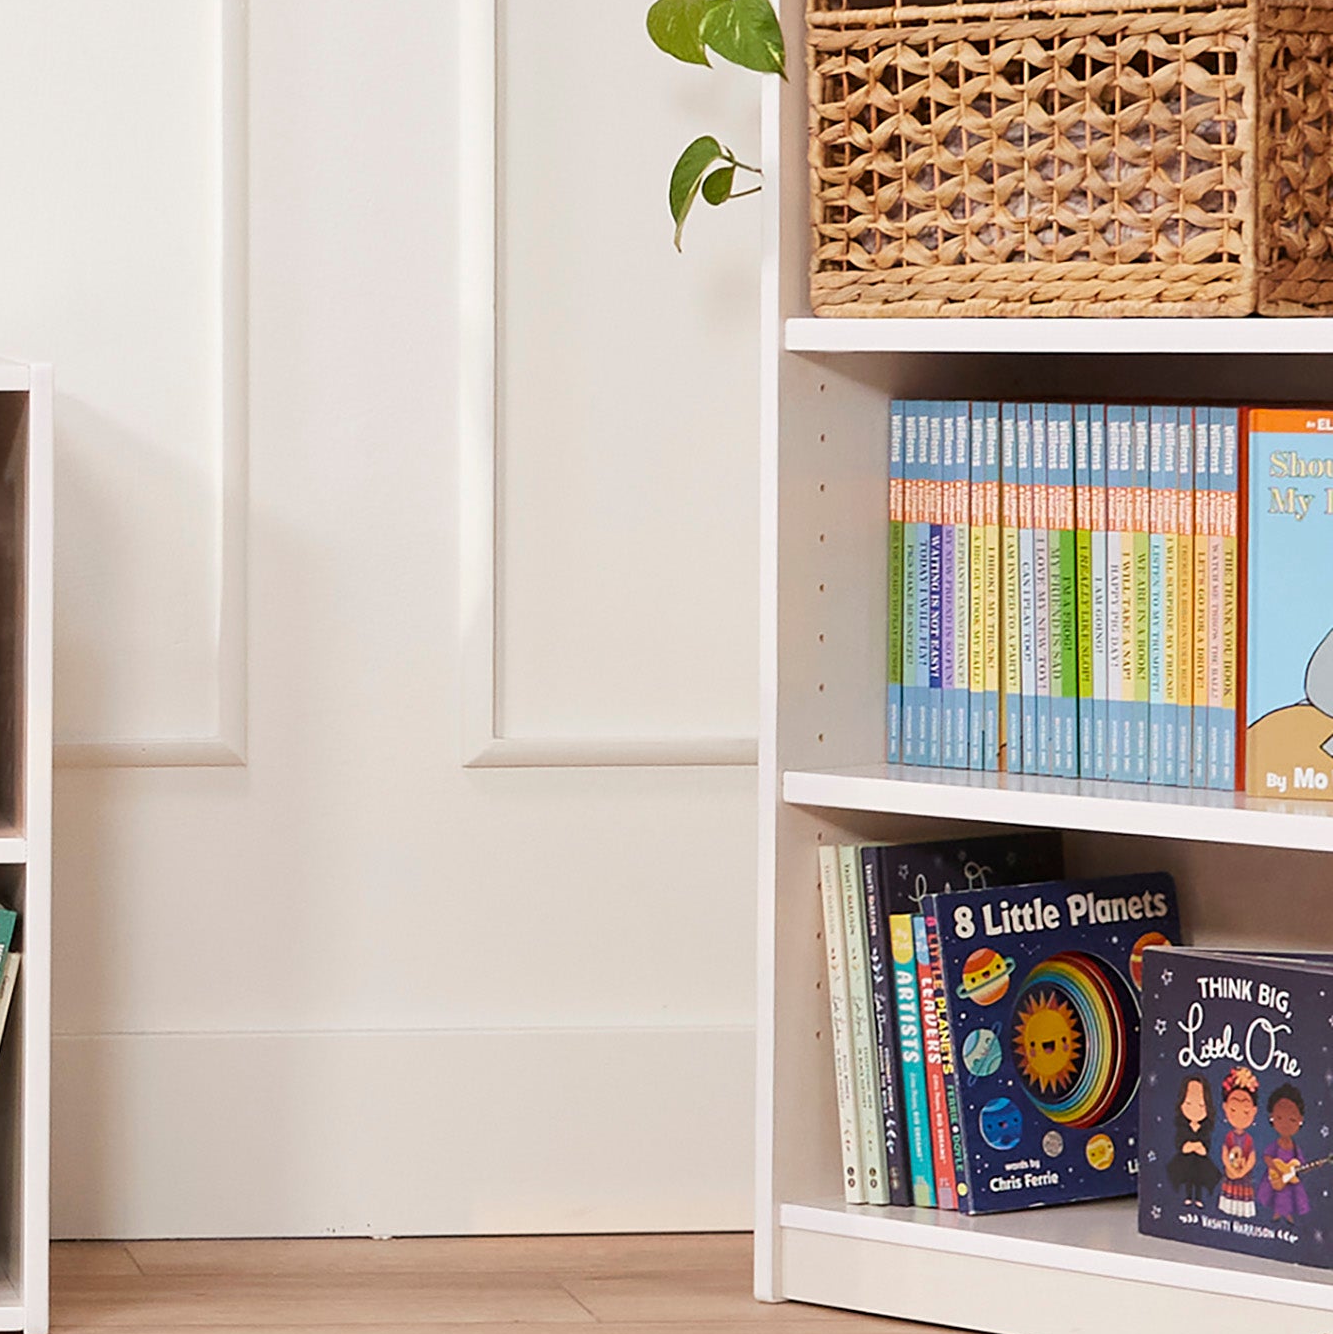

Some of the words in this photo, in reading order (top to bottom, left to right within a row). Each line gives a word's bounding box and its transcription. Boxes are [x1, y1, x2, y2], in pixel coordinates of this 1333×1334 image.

[891, 414, 902, 462] Willems
[956, 416, 967, 464] Willems
[1033, 420, 1043, 468] Willems
[1091, 421, 1103, 471] Willems
[1135, 421, 1147, 471] Willems
[1164, 423, 1176, 472] Willems
[1179, 424, 1190, 474] Willems
[1224, 425, 1235, 475] Willems
[1268, 487, 1315, 521] My
[919, 541, 927, 584] TODAY
[931, 535, 940, 592] WAITING
[1037, 548, 1045, 586] LOVE
[1050, 547, 1060, 567] MY
[1137, 553, 1145, 580] WE
[1224, 550, 1233, 577] THE
[987, 553, 995, 599] BROKE
[1095, 584, 1103, 605] AM
[1110, 564, 1118, 606] HAPPY
[1122, 558, 1130, 595] WILL
[1137, 583, 1146, 606] ARE
[918, 597, 927, 633] WILL
[931, 594, 940, 603] IS
[987, 601, 995, 619] MY
[1037, 591, 1045, 611] MY
[1051, 574, 1061, 629] FRIEND
[1122, 598, 1131, 634] TAKE
[1137, 609, 1146, 624] IN
[1224, 582, 1233, 626] THANK
[931, 611, 940, 637] NOT
[1038, 617, 1046, 653] NEW
[1052, 632, 1061, 647] IS
[1095, 609, 1103, 654] GOING!
[1111, 611, 1119, 633] PIG
[1138, 627, 1146, 635] A
[919, 637, 928, 666] FLY!
[931, 640, 940, 677] EASY!
[987, 624, 995, 669] TRUNK!
[1111, 637, 1119, 667] DAY!
[1123, 639, 1131, 647] A
[1137, 640, 1146, 680] BOOK!
[1224, 631, 1233, 656] YOU
[1038, 656, 1047, 689] TOY!
[1053, 651, 1062, 680] SAD
[1123, 650, 1131, 680] NAP!
[1224, 660, 1233, 697] BOOK
[1266, 772, 1287, 793] By
[1294, 767, 1329, 790] Mo
[953, 905, 976, 940] 8
[981, 897, 1061, 937] Little
[1066, 889, 1169, 927] Planets
[926, 932, 943, 990] LITTLE
[895, 969, 920, 1064] ARTISTS
[1197, 977, 1253, 1002] THINK
[1257, 983, 1293, 1019] BIG,
[919, 976, 940, 1065] LEADERS
[934, 996, 953, 1075] PLANETS
[1177, 1002, 1244, 1068] Little
[1245, 1017, 1301, 1077] One
[990, 1175, 1023, 1193] Chris
[1024, 1170, 1059, 1188] Ferrie
[1200, 1216, 1231, 1232] VASHTI
[1233, 1220, 1276, 1240] HARRISON
